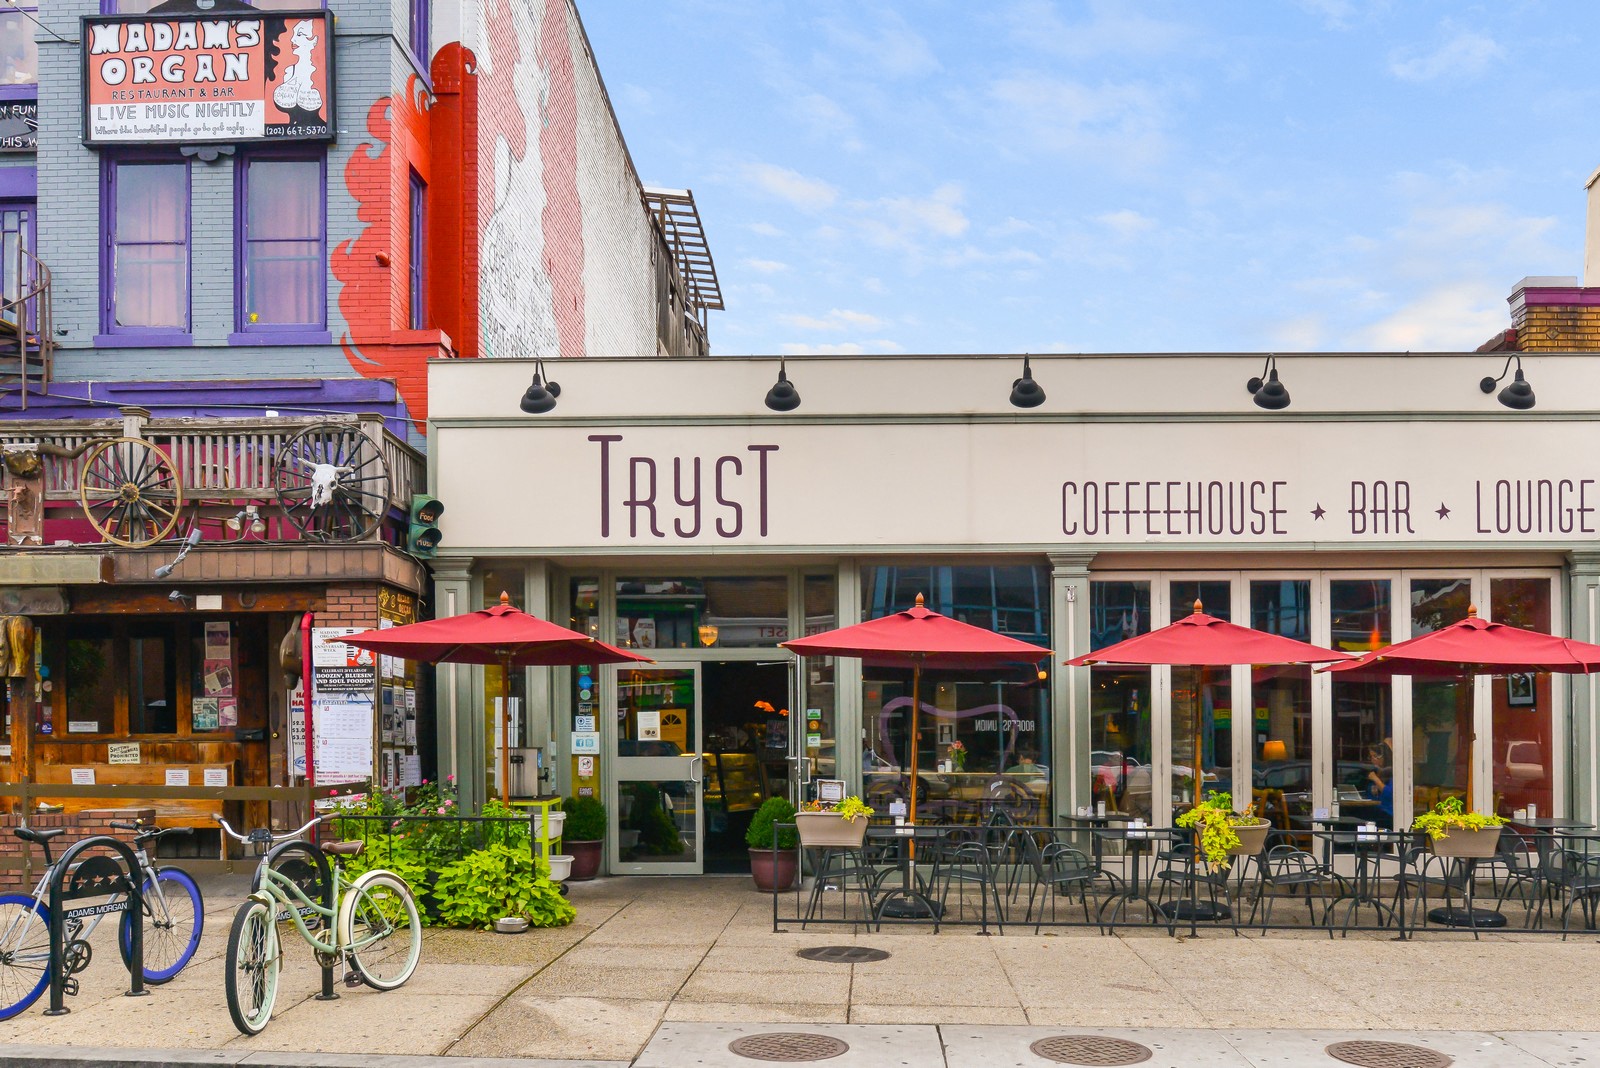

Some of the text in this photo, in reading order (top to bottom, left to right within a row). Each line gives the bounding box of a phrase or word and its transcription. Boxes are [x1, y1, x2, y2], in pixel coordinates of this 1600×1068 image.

[90, 19, 260, 55] MADAM'S
[100, 53, 249, 85] ORGAN
[112, 87, 235, 100] RESTAURANT & BAR
[12, 105, 36, 115] FUN
[97, 102, 255, 120] LIVE MUSIC NIGHTLY
[95, 125, 118, 135] Where
[119, 125, 132, 134] the
[169, 124, 192, 136] people
[193, 126, 202, 135] go
[202, 124, 211, 132] to
[212, 124, 225, 135] get
[266, 125, 327, 136] (202) 667-5370
[0, 136, 22, 147] HIS
[1062, 479, 1596, 536] COFFEEHOUSE BAR LOUNGE
[419, 511, 434, 522] Food
[67, 902, 128, 919] ADAMS MORGAN
